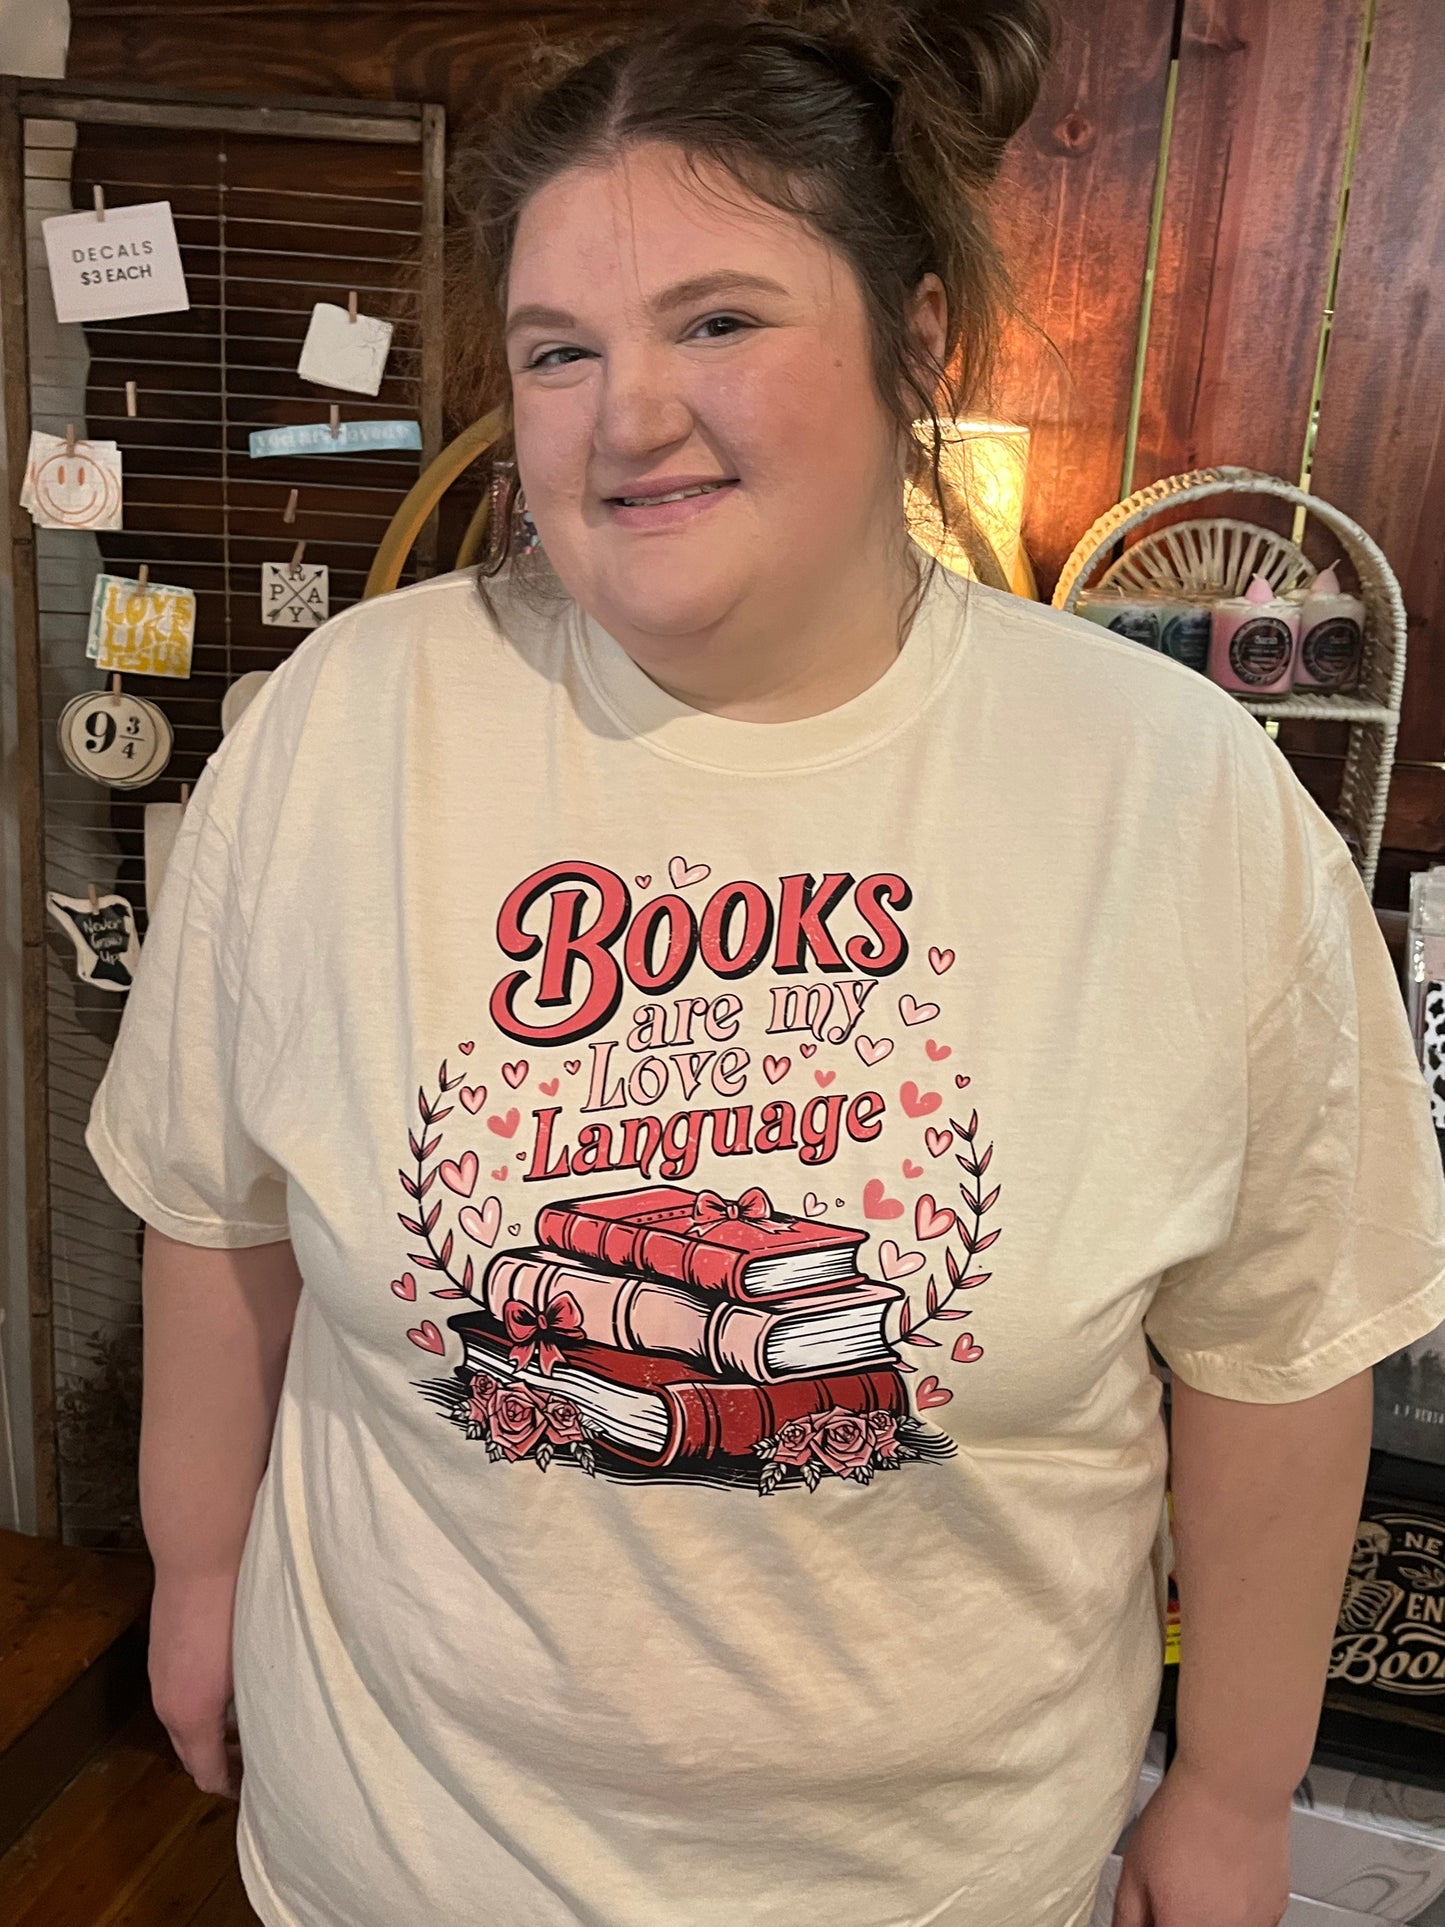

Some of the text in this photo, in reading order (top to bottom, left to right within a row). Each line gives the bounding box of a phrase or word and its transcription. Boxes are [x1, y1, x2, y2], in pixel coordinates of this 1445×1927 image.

[72, 240, 153, 263] DECALS
[80, 264, 152, 286] $3 EACH
[105, 586, 193, 625] LOVE
[85, 710, 117, 754] 9
[627, 979, 879, 1052] are my
[580, 1041, 751, 1113] Love
[523, 1091, 886, 1182] Language
[1404, 1531, 1445, 1556] NE
